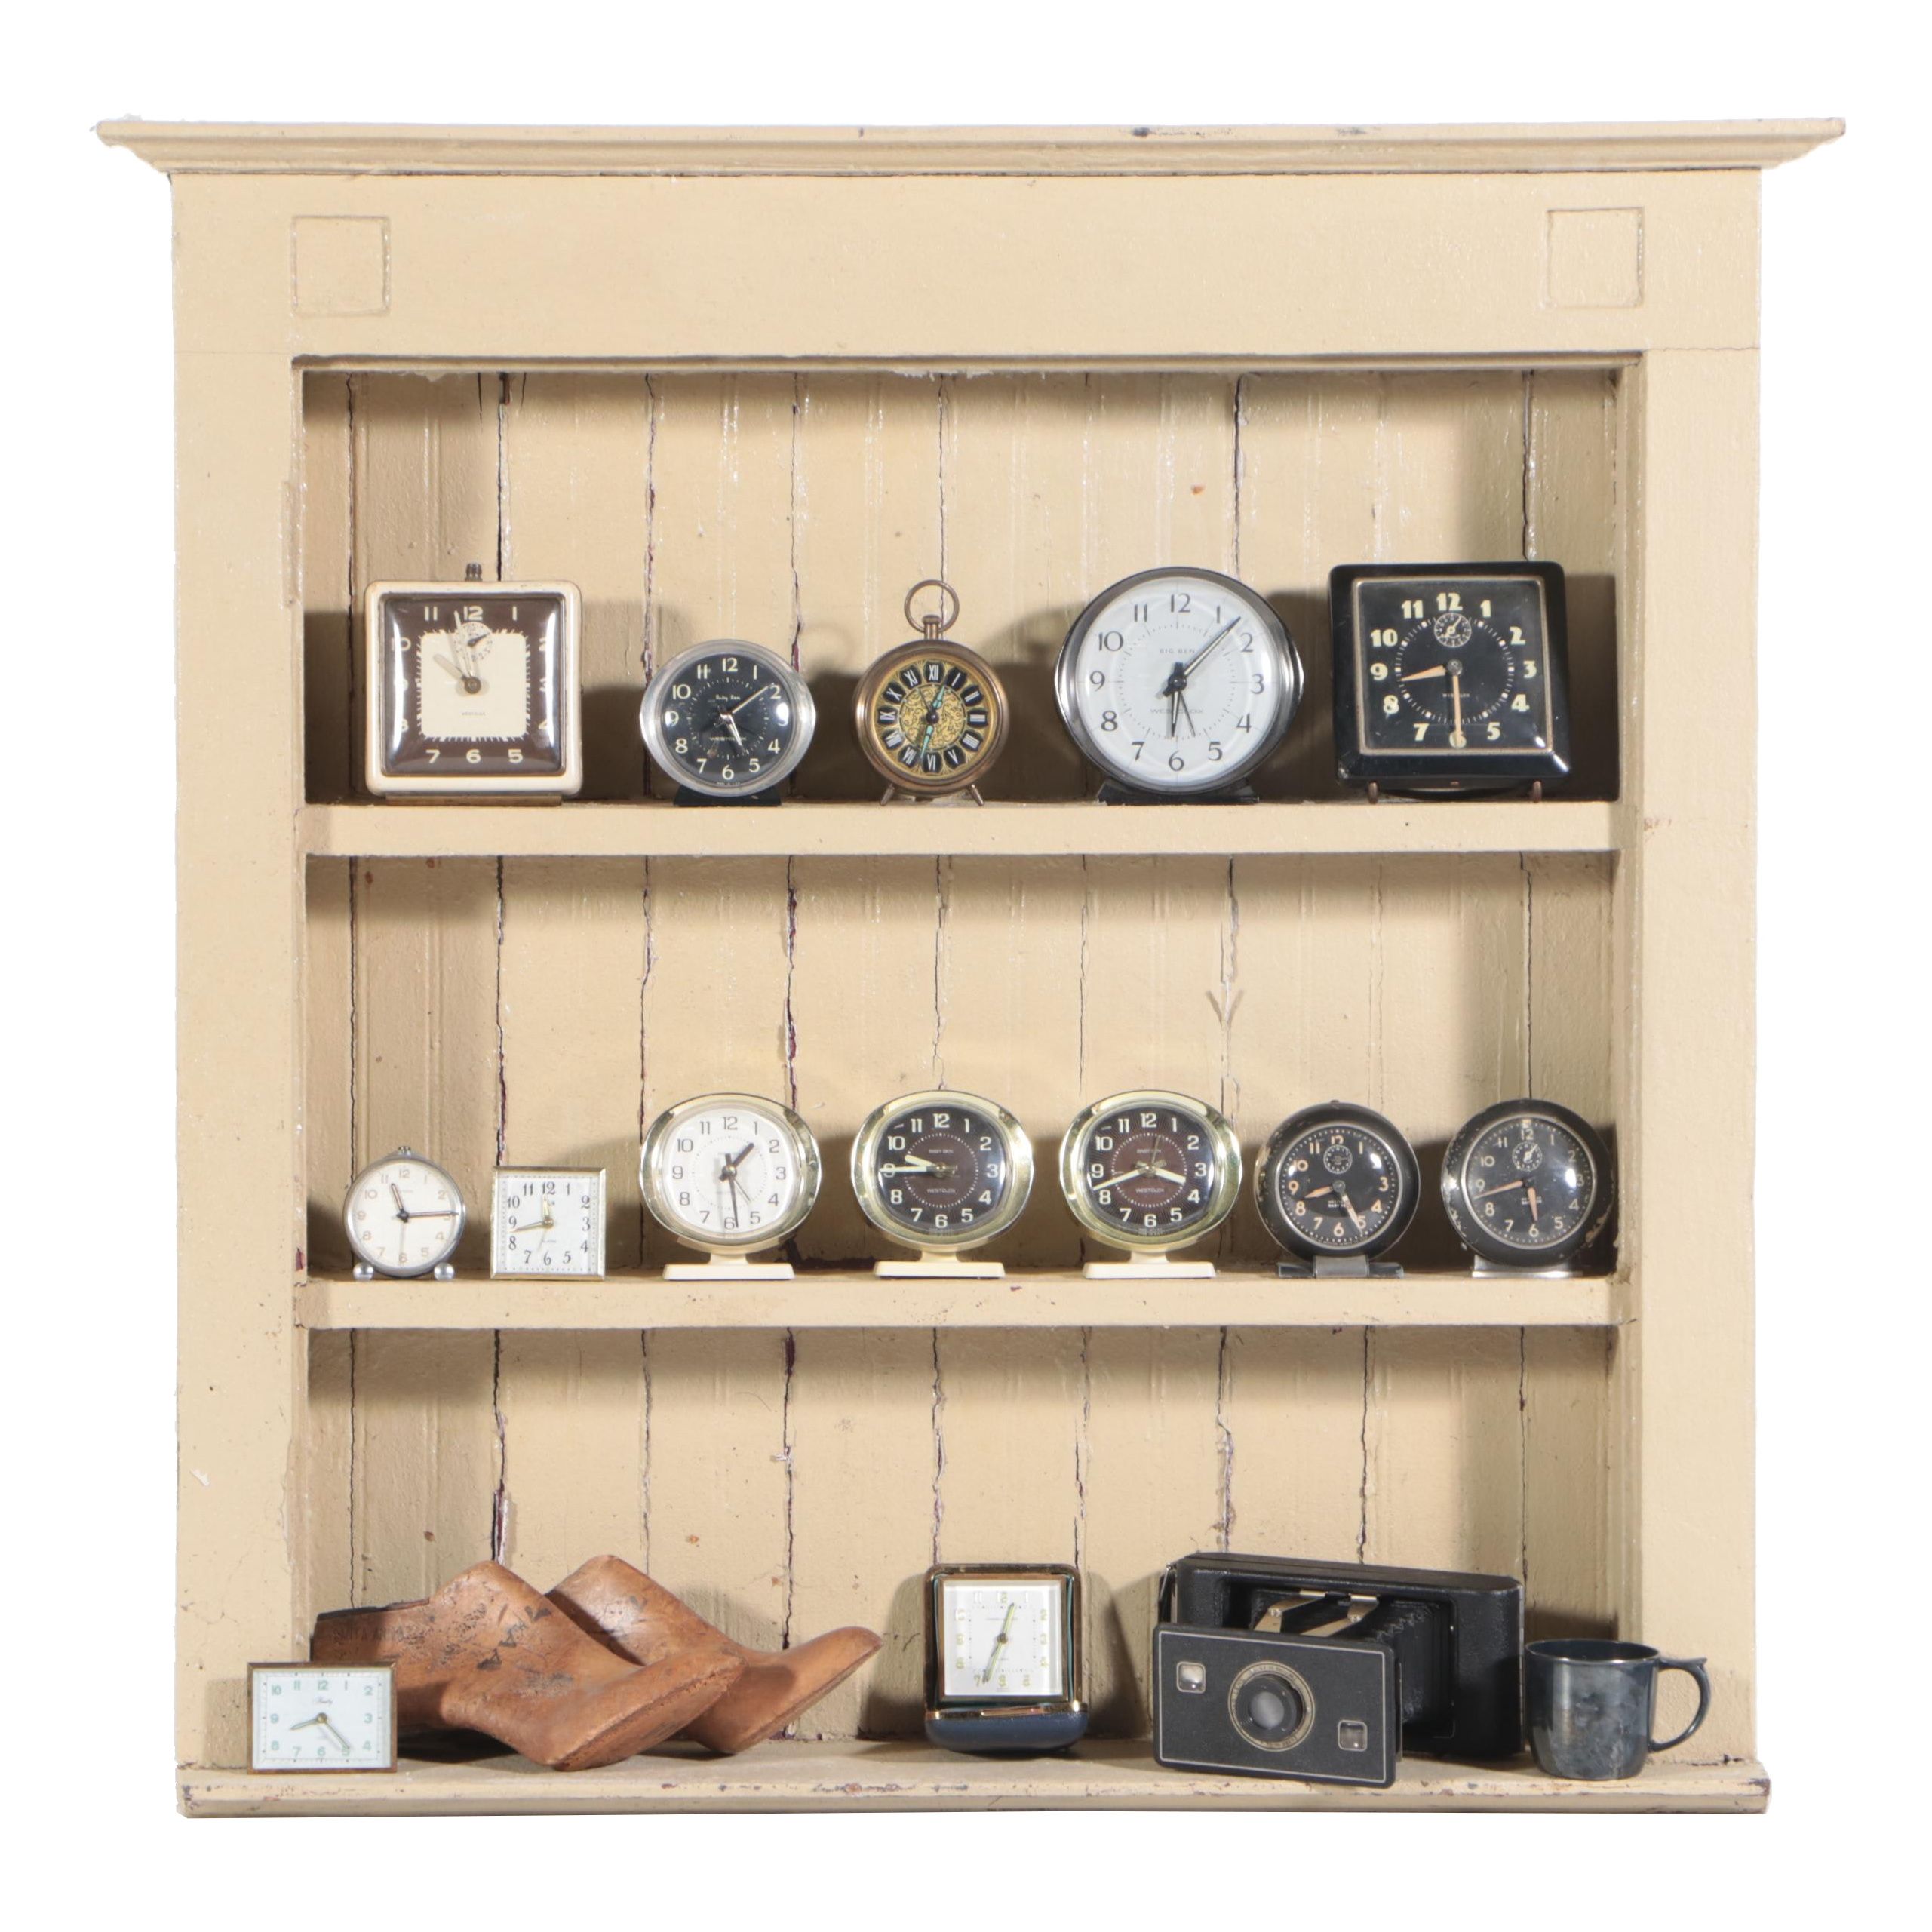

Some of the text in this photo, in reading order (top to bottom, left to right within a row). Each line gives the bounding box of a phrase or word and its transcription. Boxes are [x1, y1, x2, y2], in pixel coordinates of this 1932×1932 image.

[1170, 593, 1191, 613] 12
[1436, 593, 1463, 611] 12
[1480, 600, 1491, 617] 1
[425, 607, 437, 621] 11
[463, 607, 483, 621] 12
[512, 607, 517, 621] 1
[1134, 604, 1147, 622] 11
[1216, 606, 1221, 623] 1
[1401, 600, 1423, 619] 11
[1098, 631, 1123, 652] 10
[1240, 633, 1254, 653] 2
[1370, 628, 1398, 647] 10
[1510, 627, 1525, 645] 2
[697, 665, 708, 679] 11
[723, 658, 738, 672] 12
[1370, 663, 1387, 680] 9
[1523, 661, 1537, 678] 3
[754, 665, 757, 680] 1
[904, 670, 917, 686] XI
[929, 665, 938, 680] XII
[951, 673, 960, 686] I
[1089, 671, 1105, 691] 9
[1251, 674, 1264, 694] 3
[673, 684, 691, 699] 10
[770, 685, 781, 699] 2
[886, 688, 902, 701] X
[964, 691, 979, 702] II
[1383, 695, 1399, 714] 8
[1512, 694, 1529, 712] 4
[880, 711, 895, 720] IX
[1101, 711, 1117, 731] 8
[1236, 714, 1252, 733] 4
[1414, 723, 1430, 741] 7
[1487, 722, 1500, 741] 5
[885, 730, 902, 748] VIII
[675, 739, 688, 754] 8
[768, 739, 780, 754] 4
[1132, 742, 1145, 761] 7
[1208, 742, 1223, 761] 5
[426, 750, 440, 763] 7
[466, 749, 481, 763] 6
[508, 750, 523, 763] 5
[903, 747, 917, 765] VII
[927, 754, 935, 771] VI
[948, 750, 958, 764] V
[1169, 751, 1184, 771] 6
[697, 759, 707, 773] 7
[722, 765, 734, 779] 6
[749, 759, 760, 772] 5
[723, 1117, 738, 1130] 12
[911, 1119, 922, 1132] 11
[933, 1113, 950, 1128] 12
[965, 1119, 969, 1132] 1
[1118, 1119, 1129, 1132] 11
[1141, 1113, 1157, 1128] 12
[1172, 1118, 1177, 1132] 1
[700, 1121, 710, 1135] 11
[754, 1122, 757, 1135] 1
[1522, 1129, 1534, 1140] 12
[677, 1139, 693, 1153] 10
[769, 1140, 779, 1153] 2
[888, 1136, 905, 1150] 10
[980, 1137, 991, 1150] 2
[1095, 1136, 1113, 1150] 10
[1187, 1135, 1199, 1150] 2
[1498, 1138, 1507, 1147] 11
[1550, 1135, 1554, 1145] 1
[1310, 1142, 1320, 1154] 11
[1359, 1141, 1363, 1154] 1
[1481, 1156, 1494, 1167] 10
[1568, 1150, 1576, 1162] 2
[399, 1169, 410, 1178] 12
[673, 1166, 683, 1179] 9
[776, 1167, 786, 1180] 3
[987, 1163, 998, 1178] 3
[1092, 1164, 1104, 1178] 9
[1195, 1163, 1206, 1177] 3
[524, 1183, 533, 1196] 11
[542, 1182, 555, 1195] 12
[567, 1183, 570, 1195] 1
[1289, 1181, 1299, 1194] 9
[1379, 1177, 1388, 1191] 3
[1476, 1179, 1485, 1191] 9
[438, 1191, 446, 1199] 2
[508, 1196, 520, 1208] 10
[680, 1192, 690, 1206] 8
[768, 1193, 779, 1206] 4
[891, 1189, 902, 1204] 8
[979, 1190, 991, 1204] 4
[1100, 1190, 1111, 1205] 8
[1187, 1189, 1200, 1203] 4
[582, 1196, 590, 1209] 2
[1295, 1201, 1305, 1216] 8
[1371, 1200, 1381, 1213] 4
[1485, 1203, 1494, 1216] 8
[1569, 1199, 1579, 1210] 4
[358, 1211, 365, 1220] 9
[509, 1216, 517, 1228] 9
[700, 1211, 710, 1223] 7
[750, 1212, 760, 1224] 5
[911, 1208, 923, 1222] 7
[935, 1215, 948, 1227] 6
[961, 1209, 973, 1222] 5
[1120, 1208, 1132, 1222] 7
[1144, 1214, 1156, 1227] 6
[1171, 1208, 1182, 1222] 5
[1358, 1215, 1366, 1229] 5
[582, 1217, 590, 1231] 3
[724, 1218, 735, 1230] 6
[1314, 1218, 1323, 1230] 7
[1334, 1223, 1344, 1236] 6
[1504, 1220, 1513, 1232] 7
[1529, 1224, 1539, 1237] 6
[1554, 1217, 1563, 1230] 5
[509, 1236, 516, 1250] 8
[581, 1240, 588, 1252] 4
[378, 1247, 386, 1256] 7
[524, 1250, 531, 1264] 7
[544, 1251, 551, 1265] 6
[563, 1251, 571, 1264] 5
[272, 1685, 281, 1695] 10
[294, 1680, 300, 1690] 11
[318, 1681, 328, 1690] 12
[345, 1681, 347, 1690] 1
[364, 1685, 373, 1696] 2
[270, 1714, 279, 1724] 9
[364, 1713, 373, 1724] 3
[293, 1746, 301, 1756] 7
[318, 1746, 325, 1756] 6
